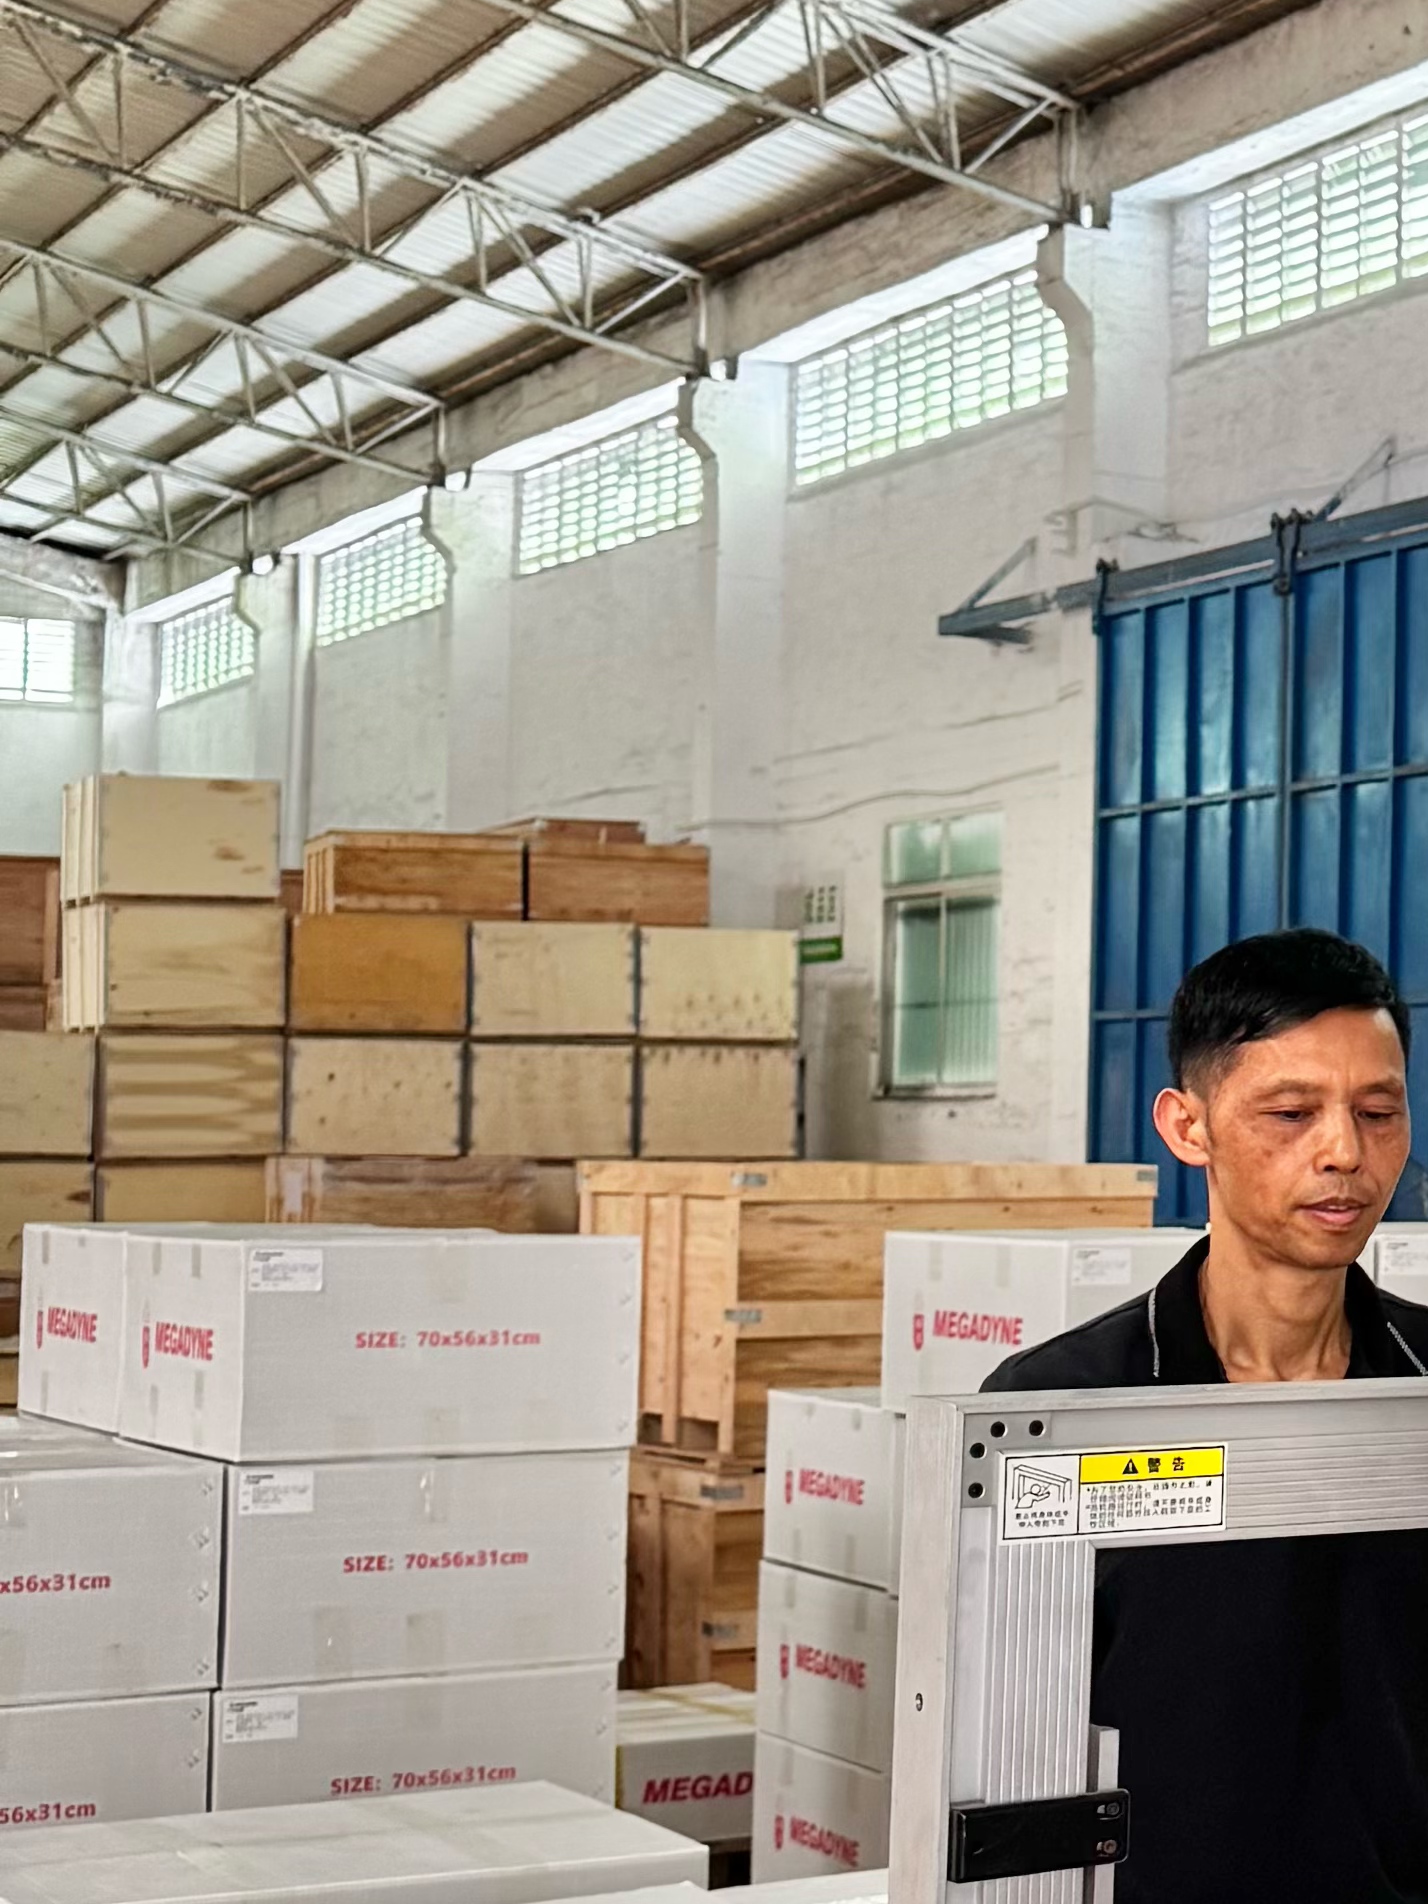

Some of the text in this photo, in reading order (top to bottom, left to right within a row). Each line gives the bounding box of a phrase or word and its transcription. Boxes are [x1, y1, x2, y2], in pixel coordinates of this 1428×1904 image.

[47, 1306, 98, 1344] MEGADYNE
[355, 1329, 542, 1349] SIZE: 70x56x31cm
[932, 1310, 1024, 1347] MEGADYNE
[154, 1321, 214, 1362] MEGADYNE
[1147, 1456, 1186, 1474] 警告
[343, 1549, 530, 1574] SIZE: 70x56x31cm
[331, 1766, 517, 1794] SIZE: 70x56x31cm
[643, 1772, 753, 1804] MEGAD
